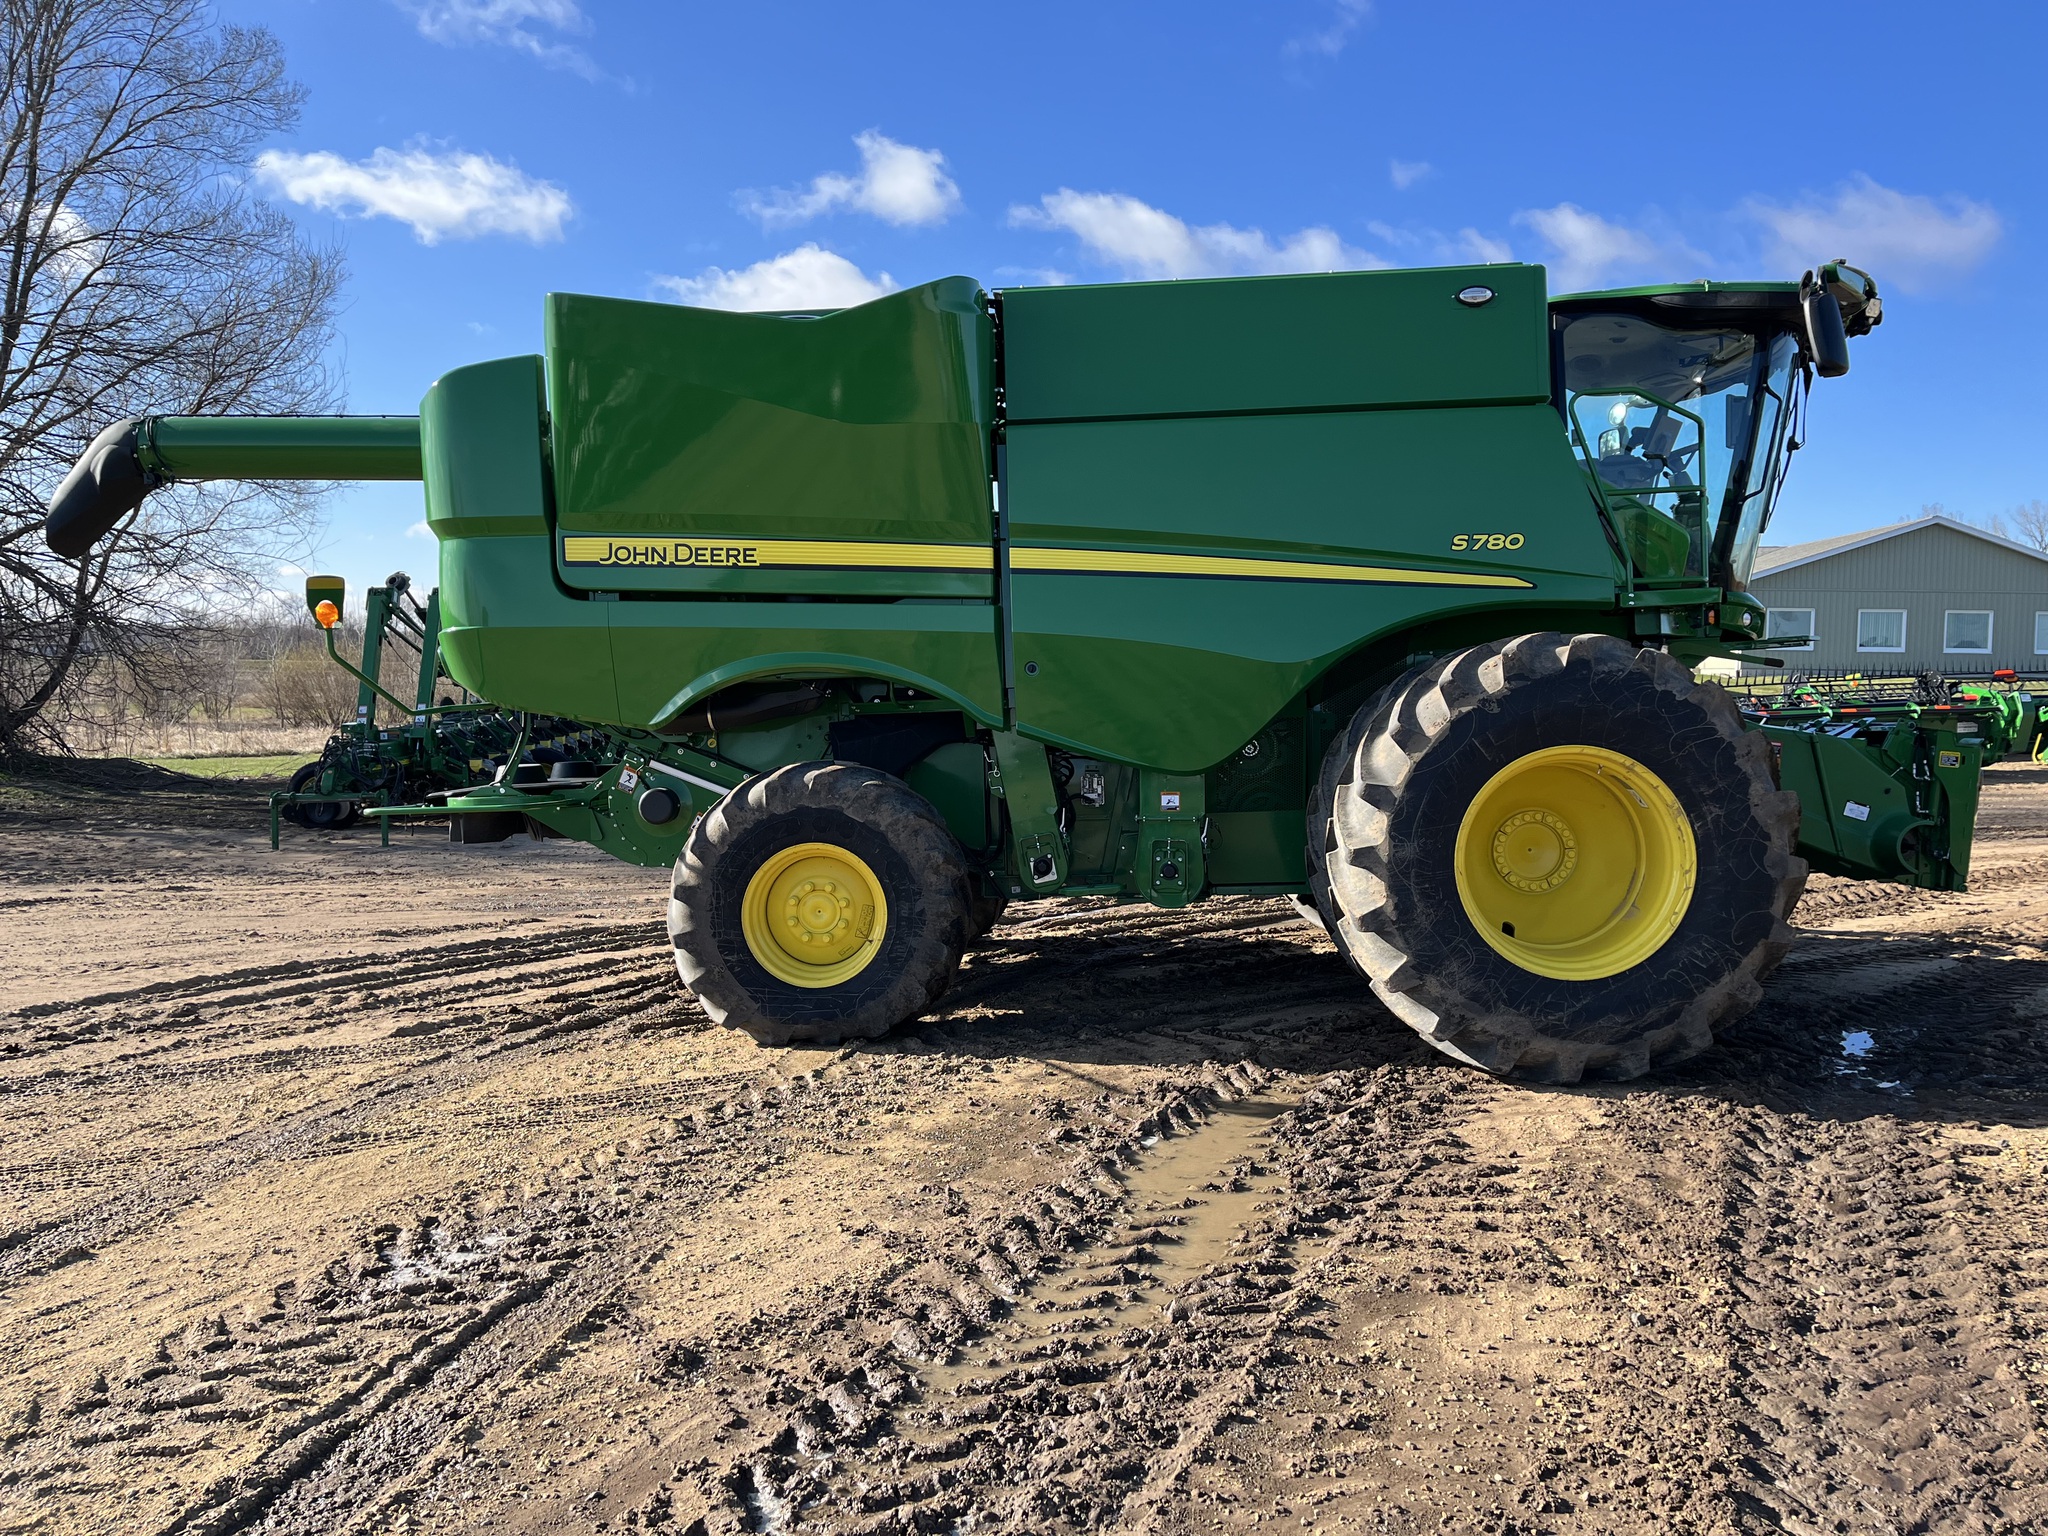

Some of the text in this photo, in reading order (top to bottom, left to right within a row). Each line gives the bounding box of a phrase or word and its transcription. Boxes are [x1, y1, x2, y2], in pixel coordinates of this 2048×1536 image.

[1451, 533, 1525, 551] S780
[599, 542, 759, 565] JOHN DEERE
